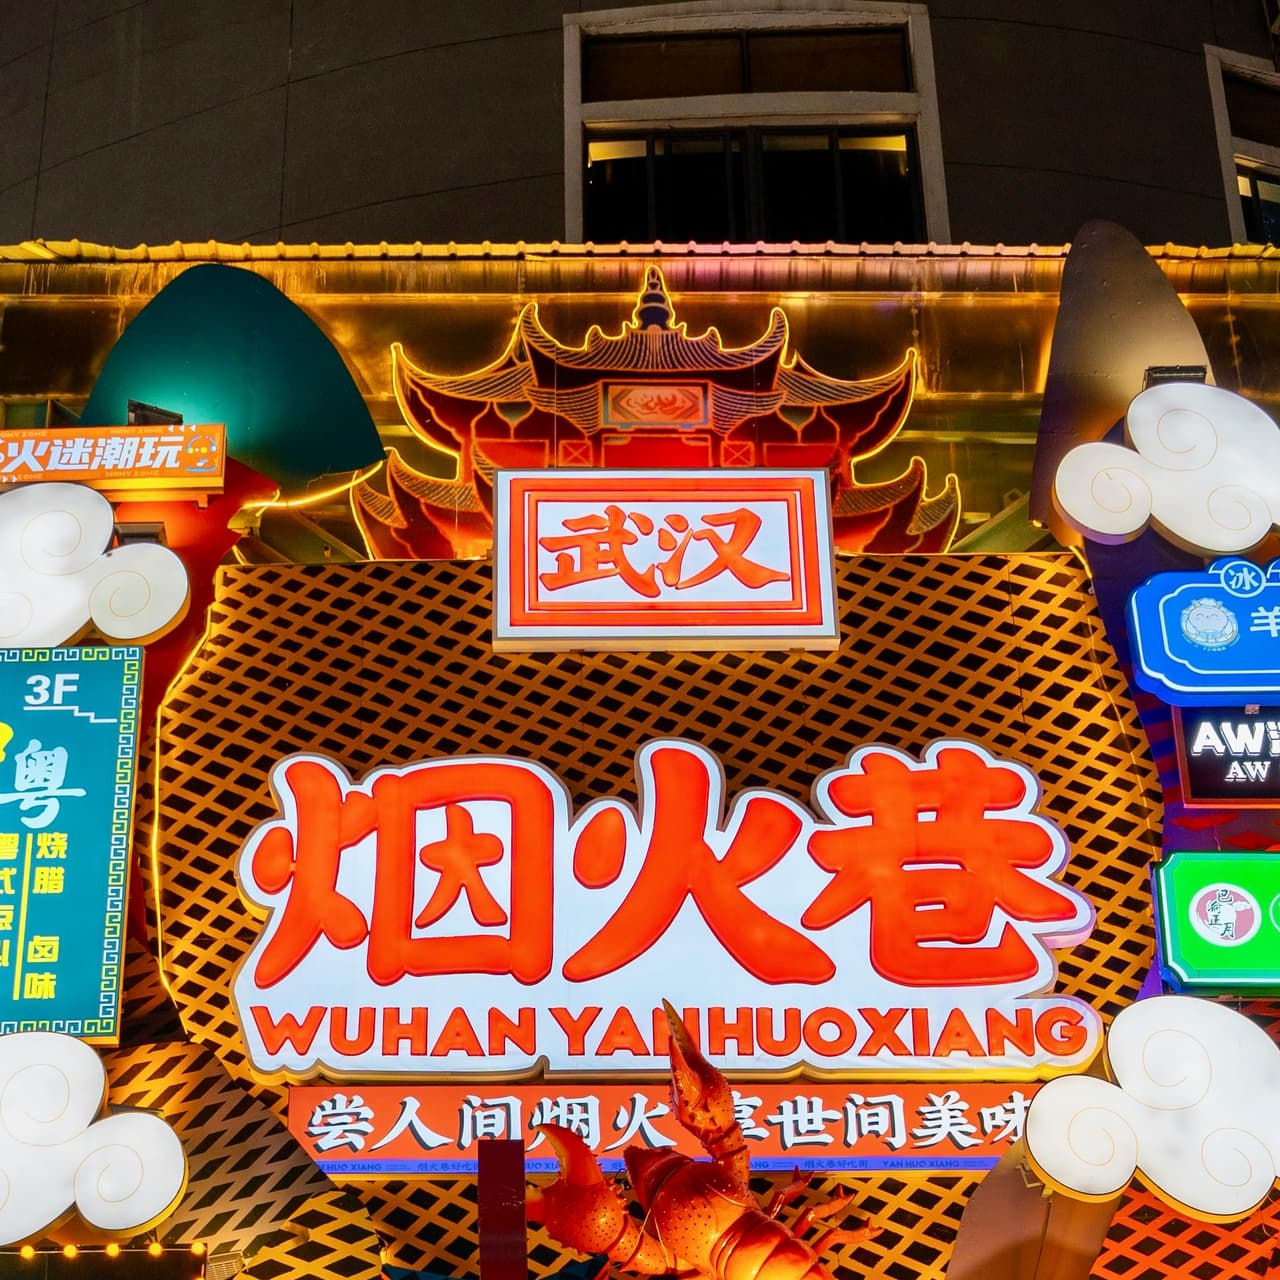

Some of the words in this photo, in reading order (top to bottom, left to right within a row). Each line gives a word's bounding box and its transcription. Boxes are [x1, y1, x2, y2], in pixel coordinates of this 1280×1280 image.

[0, 436, 184, 473] 火迷潮玩
[537, 505, 790, 598] 武汉
[24, 674, 81, 706] 3F
[1226, 761, 1272, 782] AW
[33, 832, 68, 895] 烧腊
[251, 746, 1080, 988] 烟火巷
[23, 937, 60, 1001] 卤味
[251, 1005, 541, 1058] WUHAN
[548, 1006, 1088, 1057] YANHUOXIANG
[308, 1093, 679, 1152] 尝人间烟火
